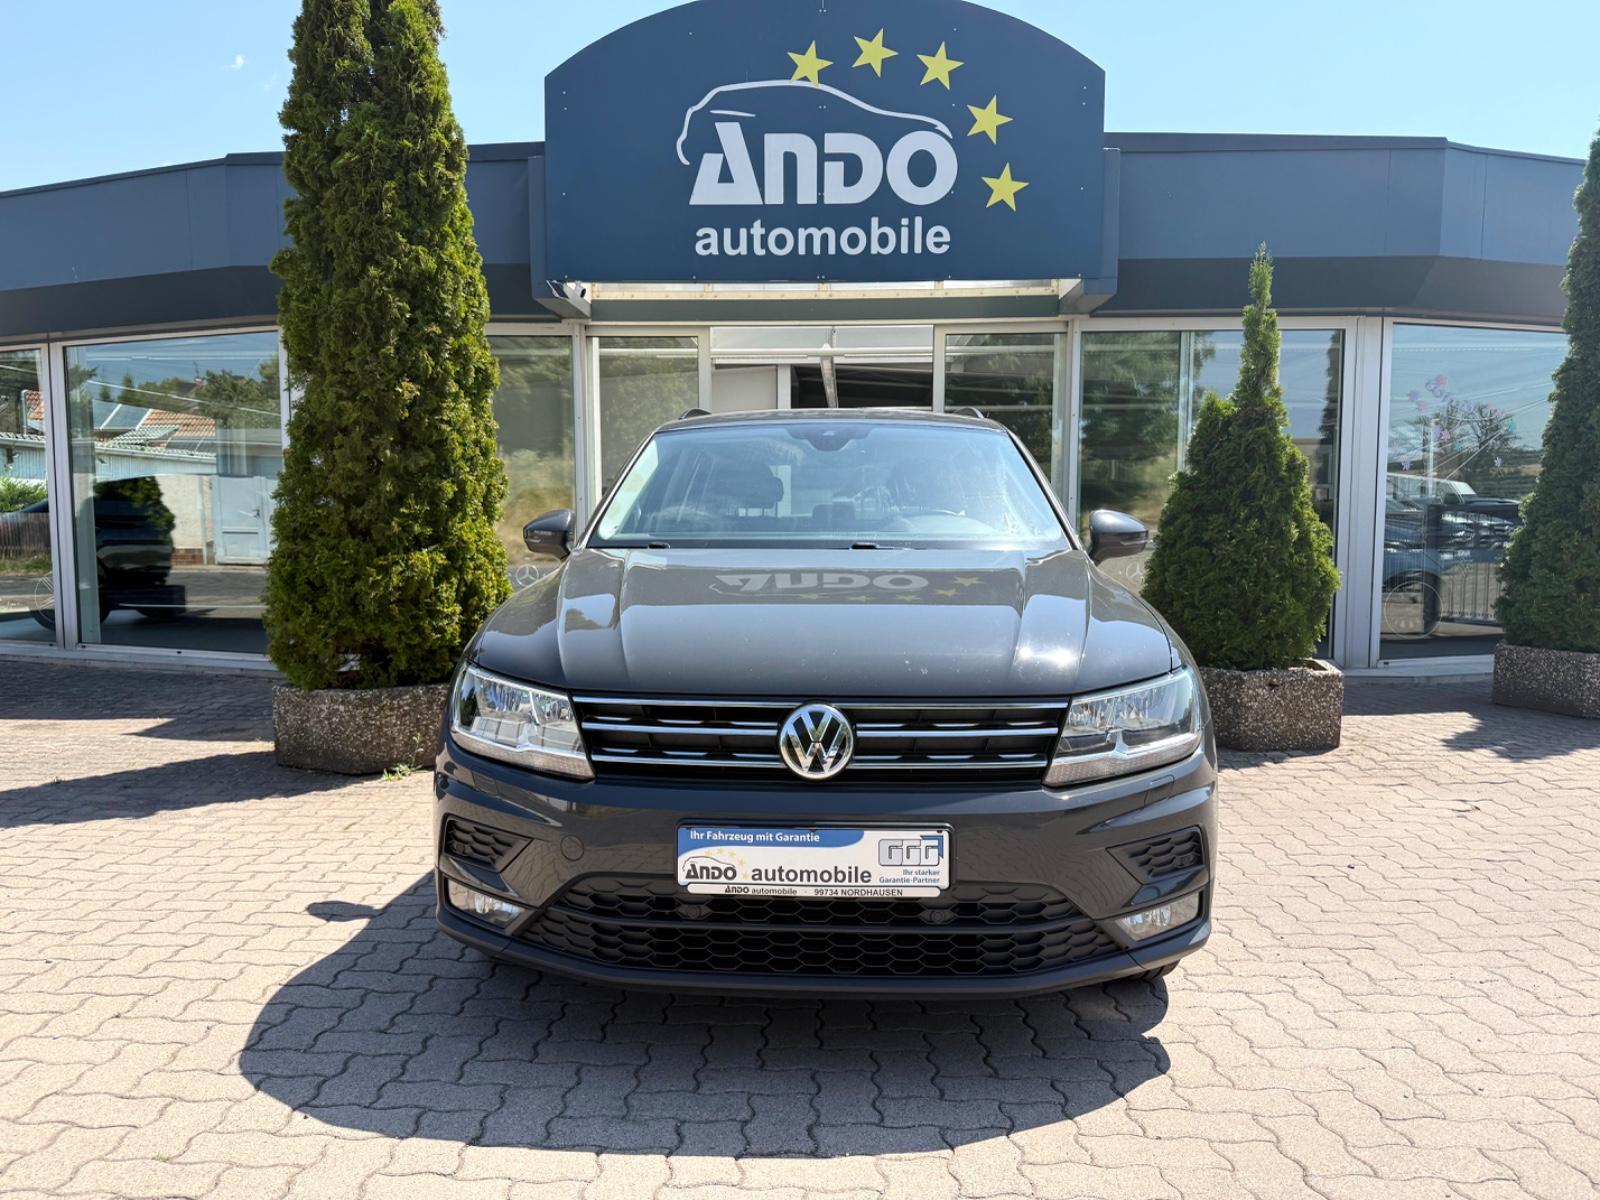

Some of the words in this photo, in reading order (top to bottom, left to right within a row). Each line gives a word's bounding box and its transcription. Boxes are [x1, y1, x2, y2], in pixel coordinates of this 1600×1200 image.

[689, 121, 958, 206] ANDO
[695, 216, 951, 255] automobile
[690, 830, 705, 840] Ihr
[706, 831, 754, 843] Fahrzeug
[755, 832, 773, 842] mit
[775, 832, 820, 843] Garantie
[685, 863, 737, 881] ANDO
[751, 865, 872, 883] automobile
[902, 868, 913, 876] Ihr
[914, 868, 940, 876] starker
[879, 876, 940, 884] Garantie-Partner
[724, 885, 750, 894] ANDO
[751, 887, 798, 896] automobile
[813, 888, 839, 896] 99734
[840, 888, 903, 897] NORDHAUSEN
